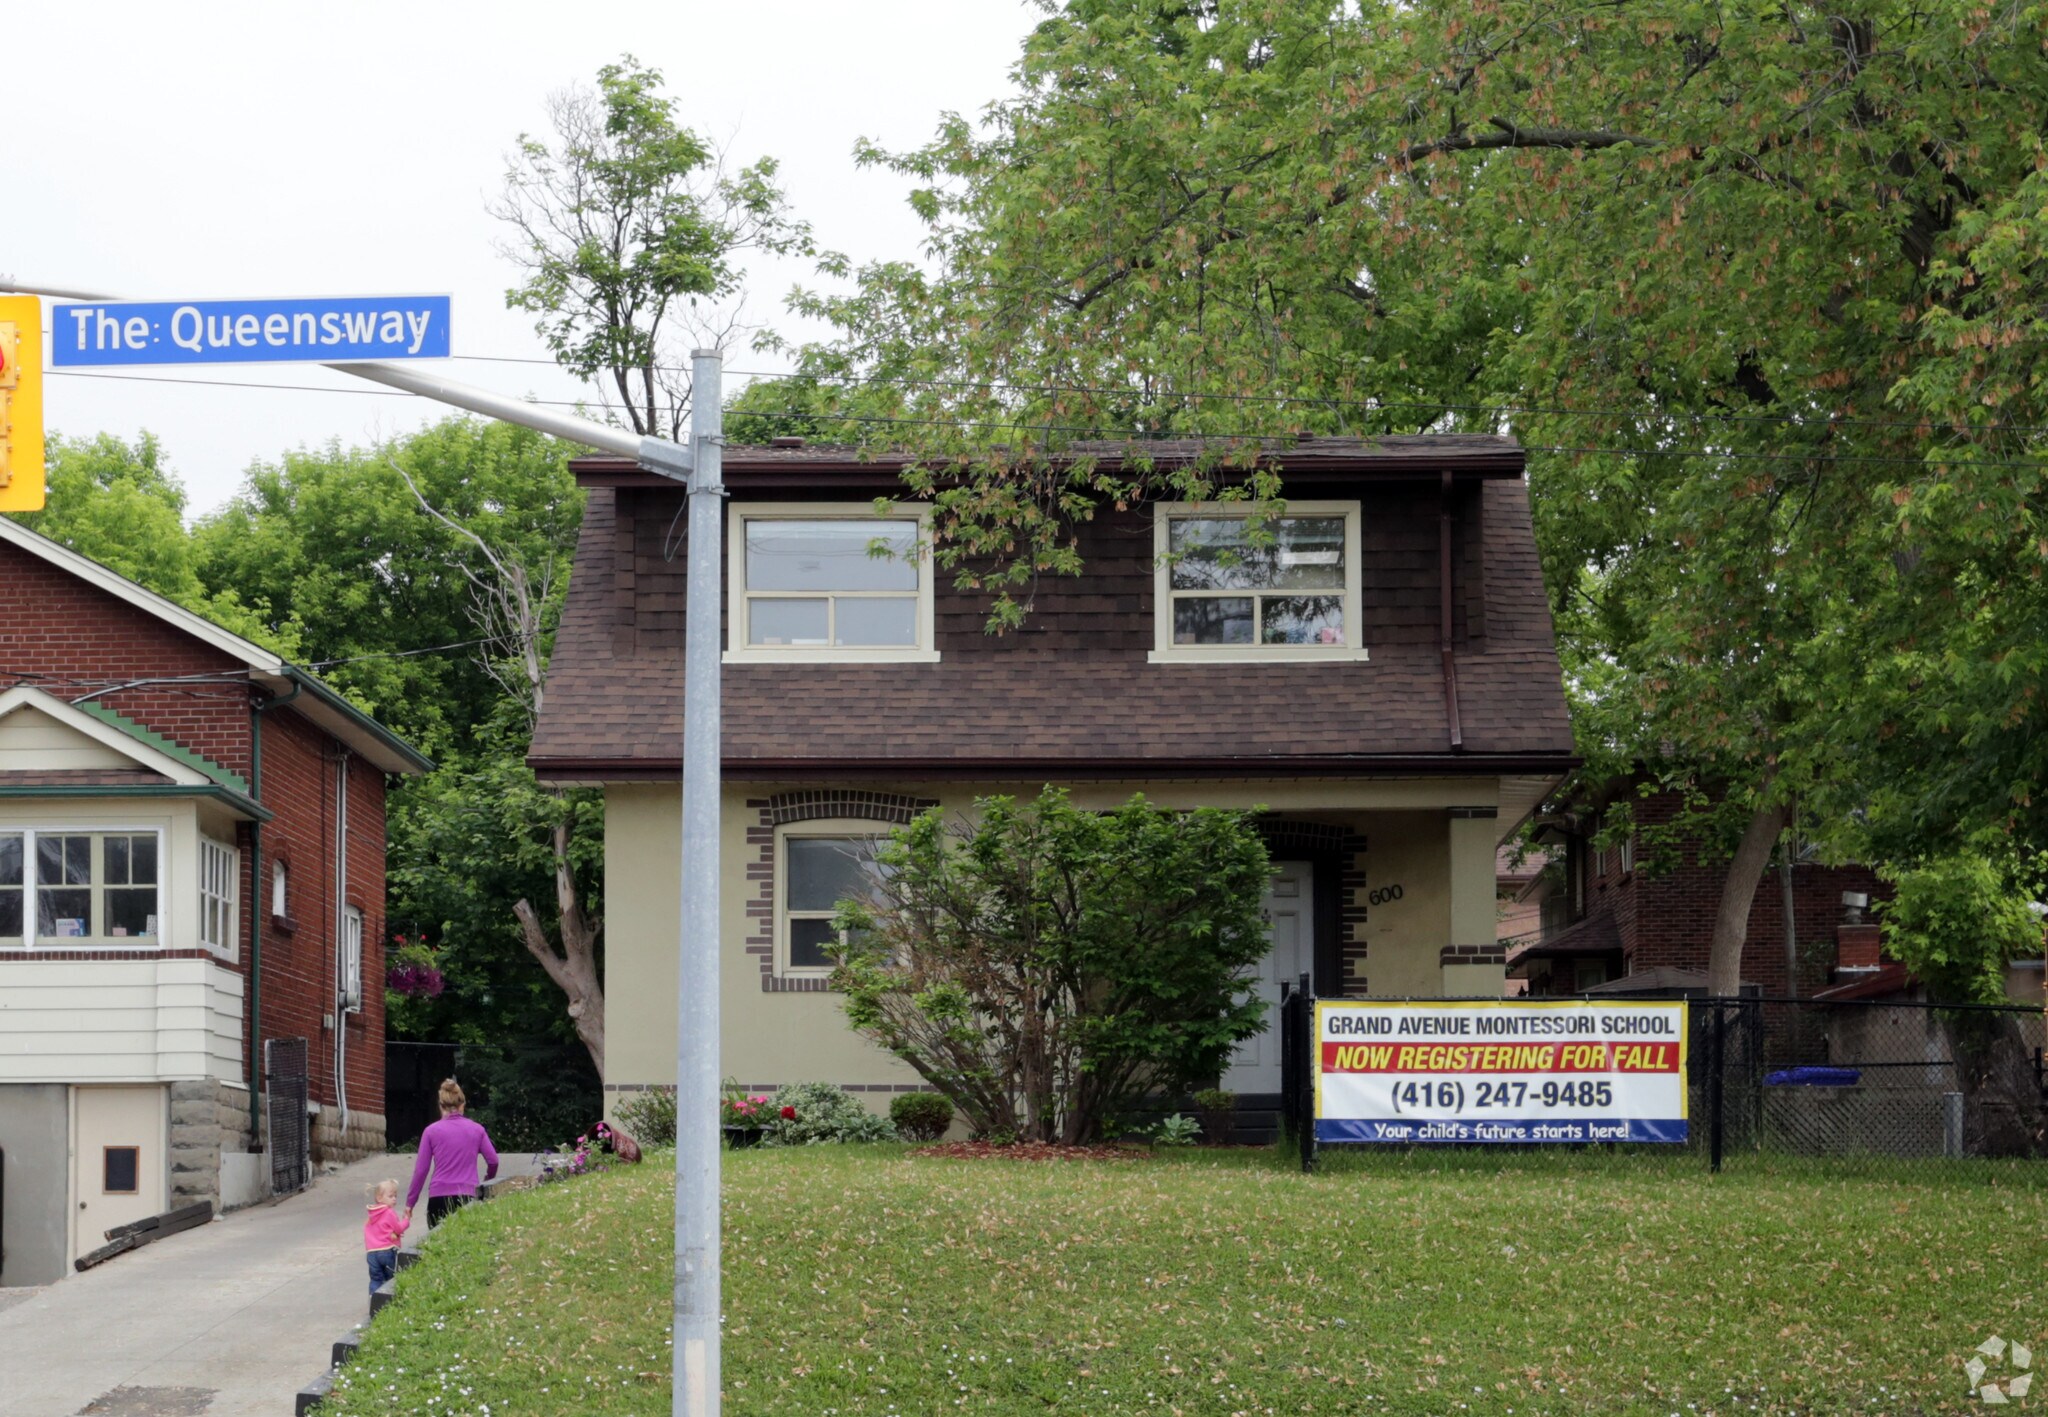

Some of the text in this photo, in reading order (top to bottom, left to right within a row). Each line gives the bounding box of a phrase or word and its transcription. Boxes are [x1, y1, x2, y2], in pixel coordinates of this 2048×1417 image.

[170, 306, 431, 354] Queensway
[1369, 884, 1403, 905] 600
[1328, 1015, 1675, 1035] GRAND AVENUE MONTESSORI SCHOOL
[1335, 1046, 1669, 1070] NOW REGISTERING FOR FALL
[1391, 1081, 1612, 1114] (416) 247-9485
[1374, 1123, 1629, 1139] Your child's future starts here!
